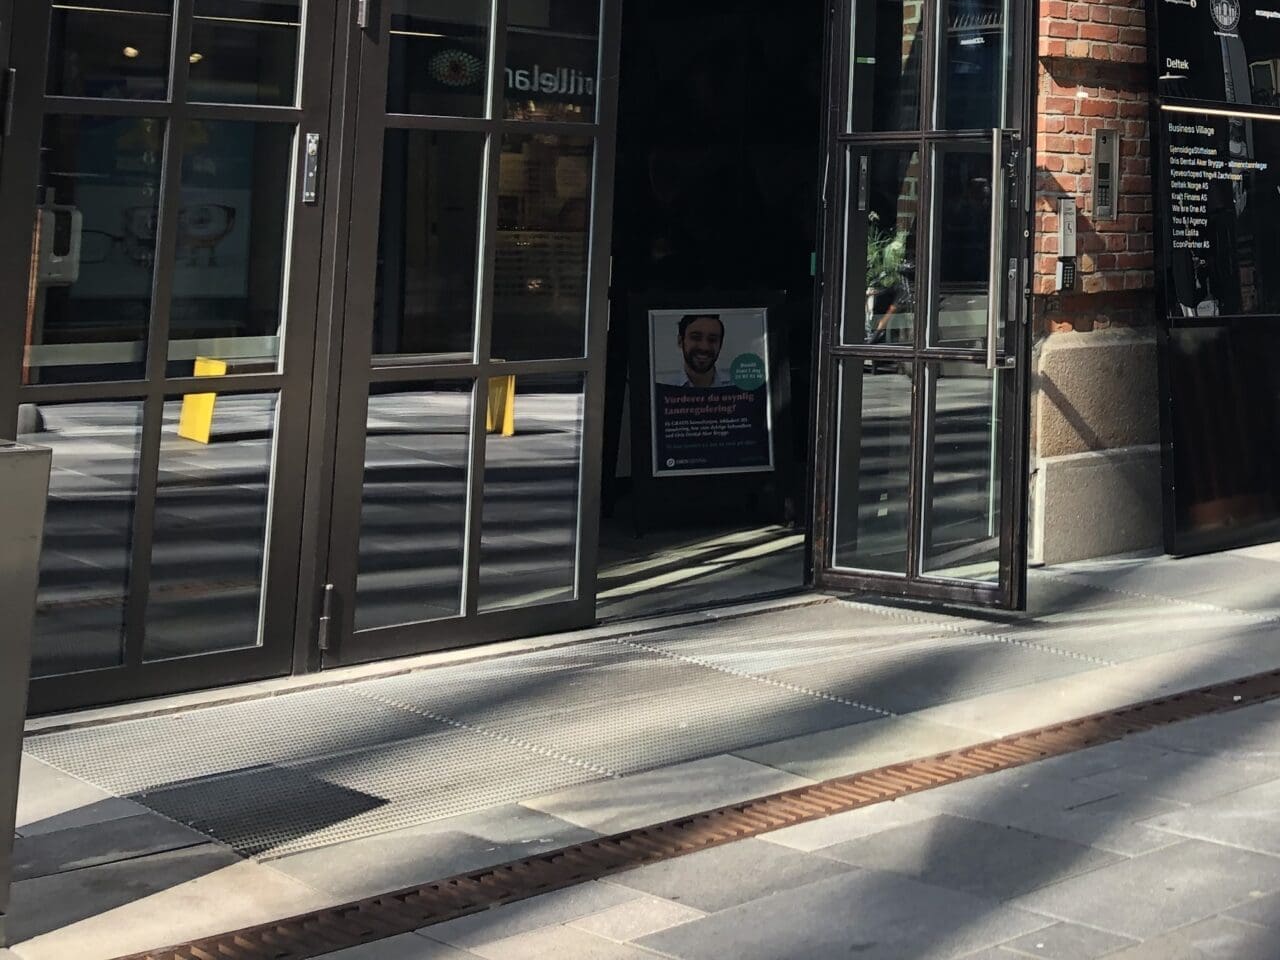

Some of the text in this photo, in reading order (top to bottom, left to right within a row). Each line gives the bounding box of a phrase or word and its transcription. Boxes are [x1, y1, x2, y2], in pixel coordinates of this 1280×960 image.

[1166, 57, 1190, 70] Deltek
[1168, 123, 1215, 137] Business Village
[1201, 194, 1208, 202] AS
[1189, 217, 1208, 227] Agency
